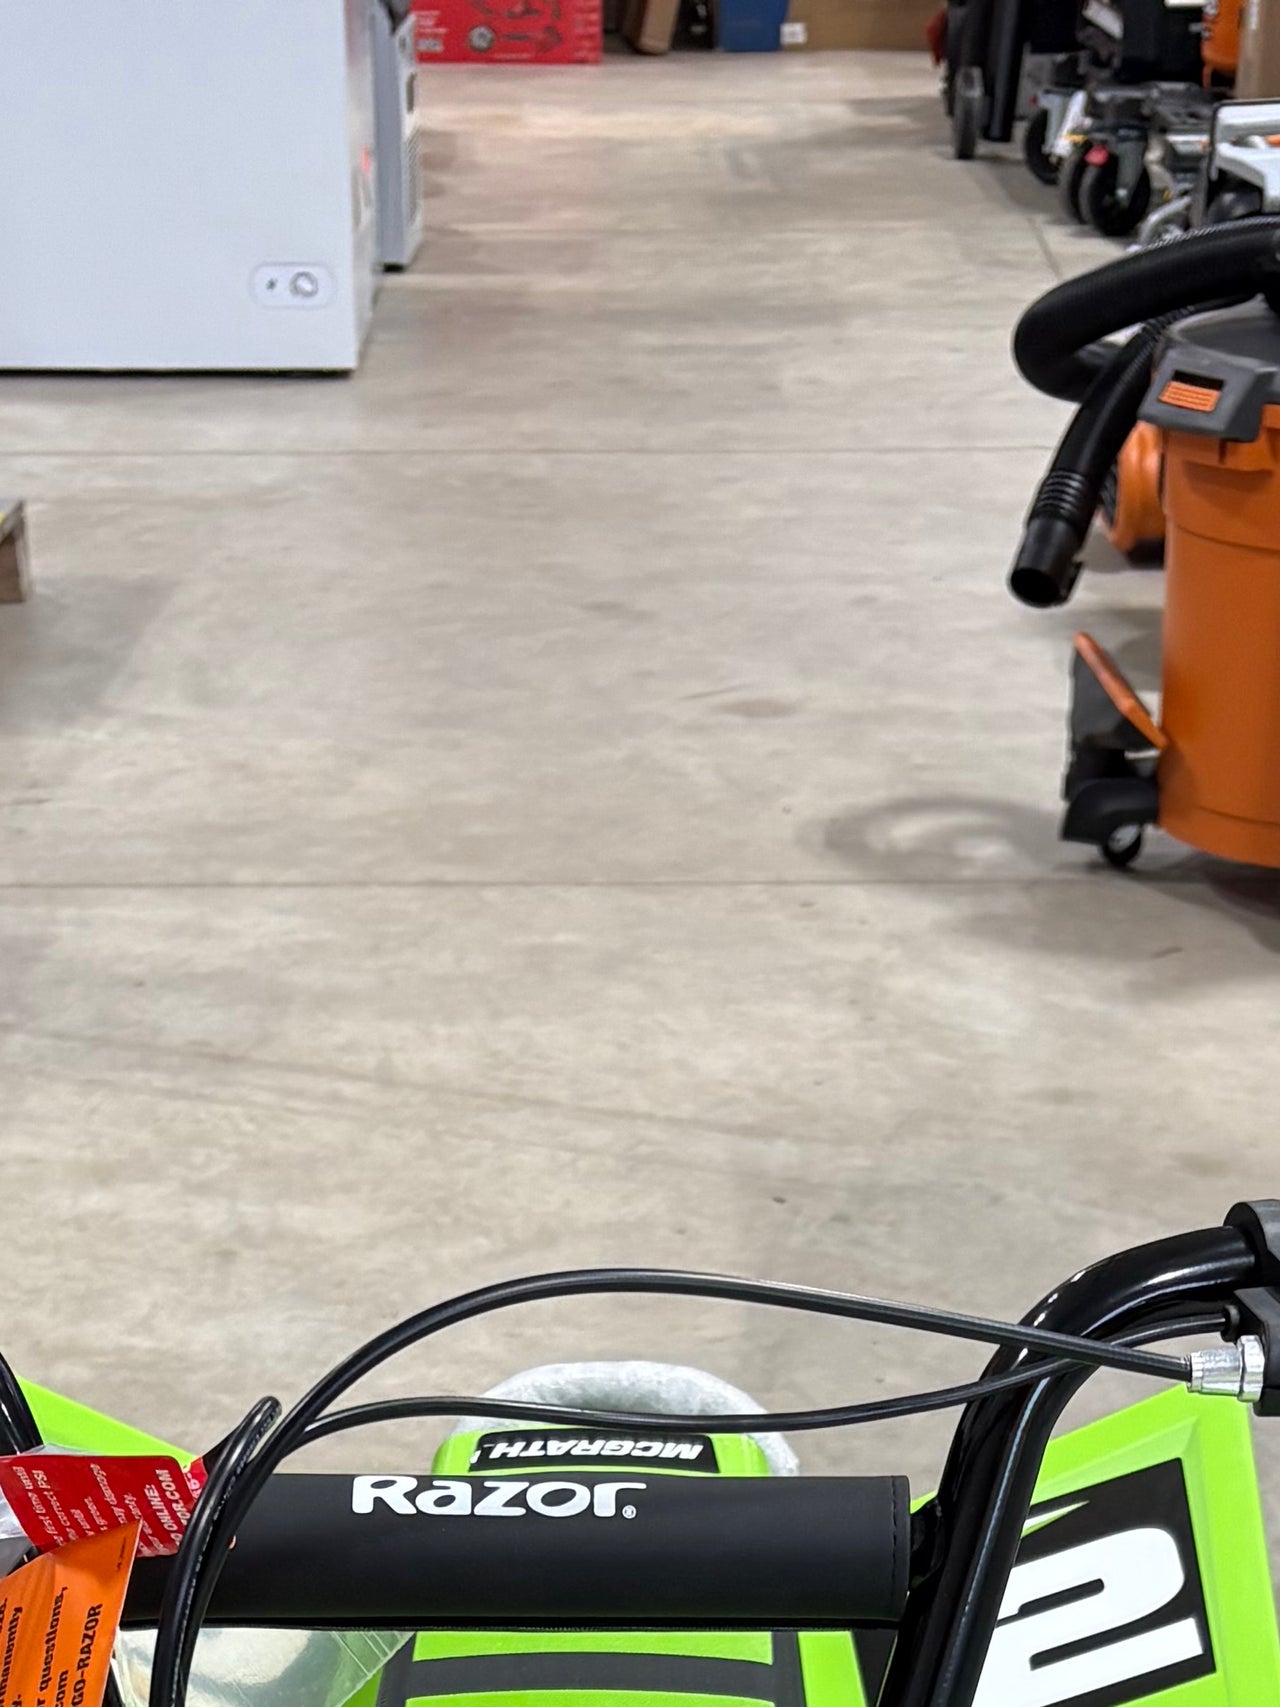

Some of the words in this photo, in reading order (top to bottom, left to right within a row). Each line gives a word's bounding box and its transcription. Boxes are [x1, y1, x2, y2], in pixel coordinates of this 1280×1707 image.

[490, 1436, 705, 1461] MCGRATH
[352, 1475, 647, 1518] Razor
[39, 1586, 68, 1693] questions,
